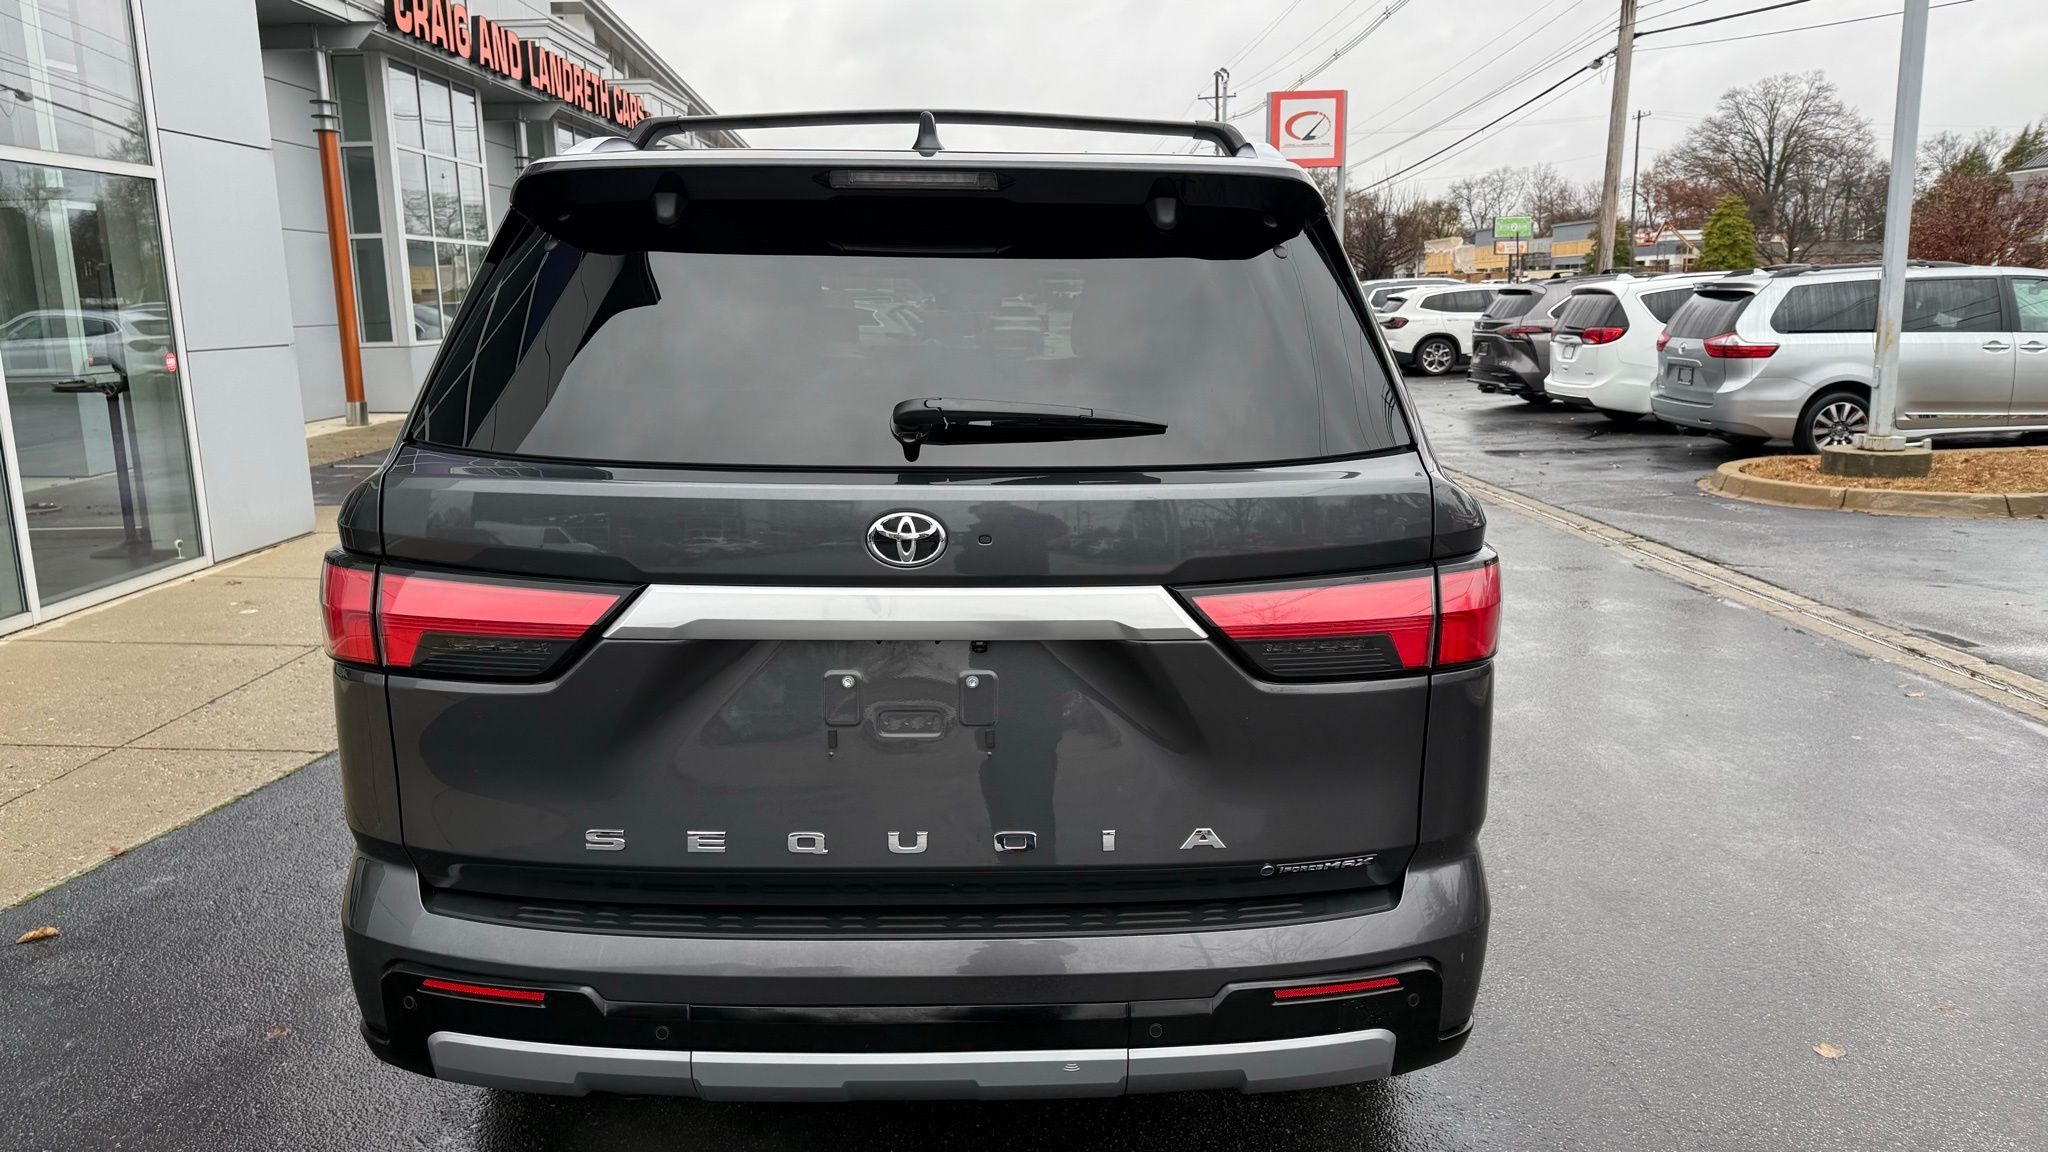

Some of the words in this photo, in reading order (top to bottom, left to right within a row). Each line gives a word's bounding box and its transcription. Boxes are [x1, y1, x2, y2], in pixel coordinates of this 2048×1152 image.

[394, 0, 472, 59] CRAIG
[479, 15, 523, 80] AND
[527, 40, 611, 119] LANDRETH
[613, 84, 645, 129] CARS
[585, 828, 1227, 856] SEQUOIA
